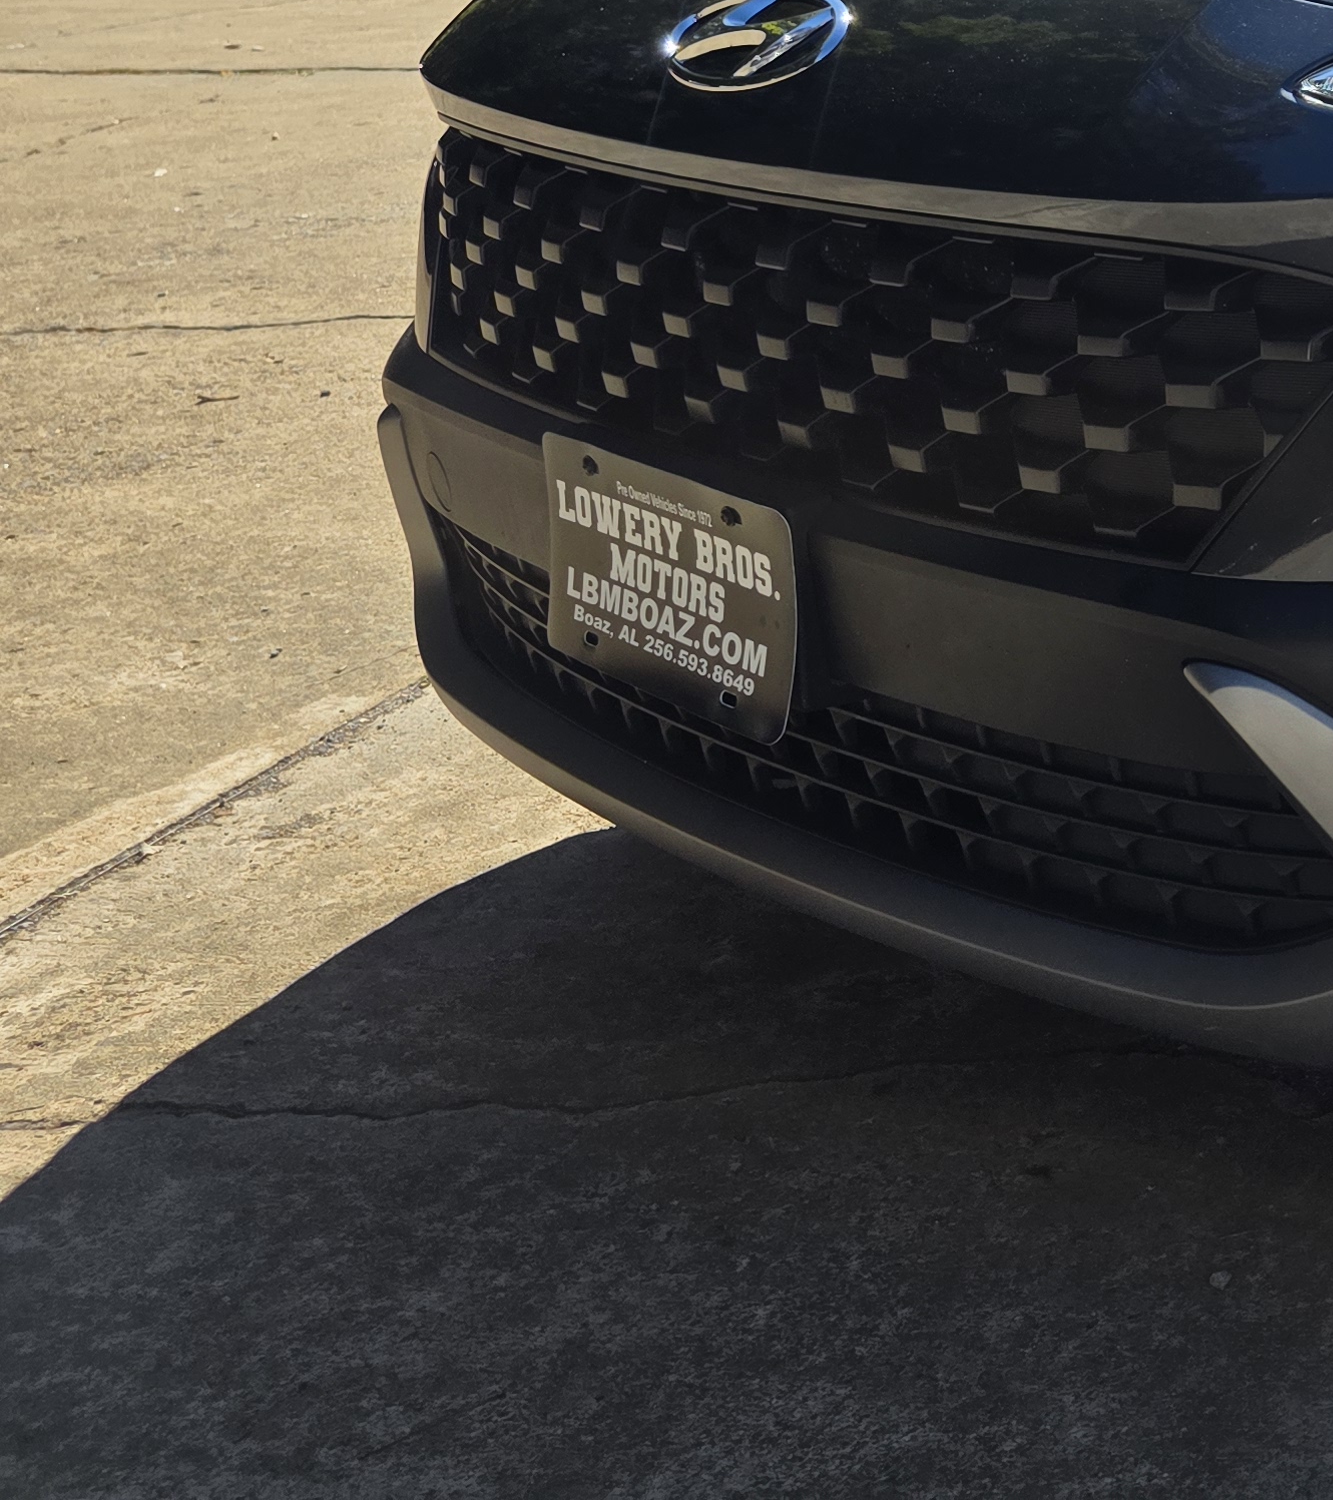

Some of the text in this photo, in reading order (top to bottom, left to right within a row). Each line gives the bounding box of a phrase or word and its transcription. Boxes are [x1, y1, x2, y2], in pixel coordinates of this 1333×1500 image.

[556, 479, 781, 601] LOWERY BROS.
[616, 480, 629, 497] Pre
[628, 485, 651, 506] Owned
[650, 493, 678, 515] Vehicles
[677, 502, 697, 522] Since
[566, 565, 768, 678] LBMBOAZ.COM
[610, 542, 726, 623] MOTORS
[573, 604, 755, 697] Boaz, AL 256.593.8649
